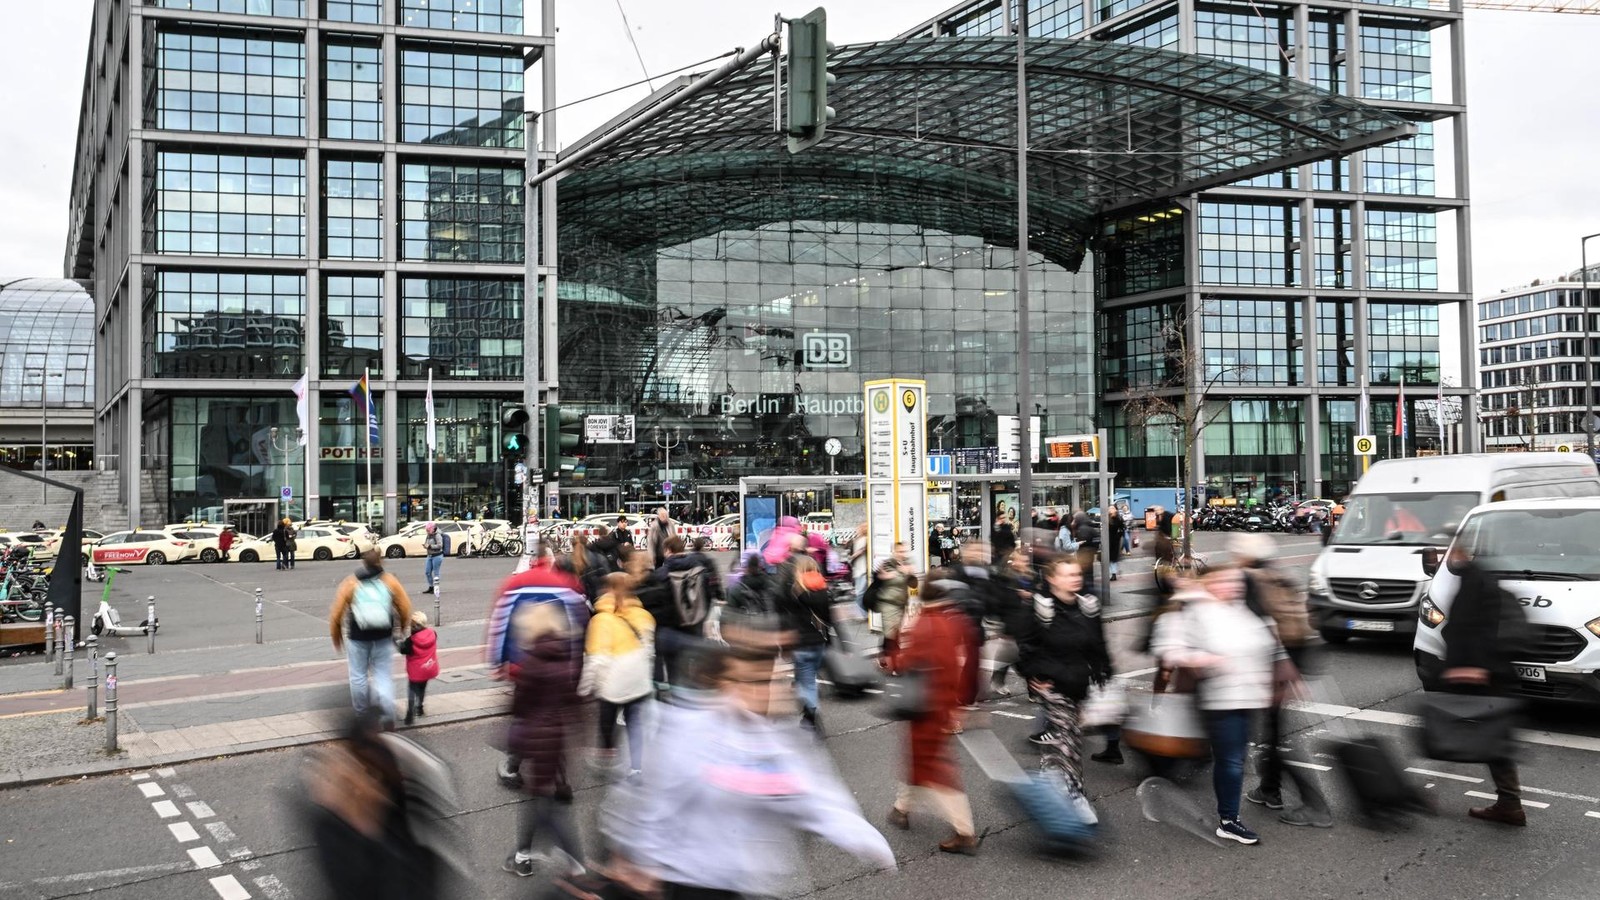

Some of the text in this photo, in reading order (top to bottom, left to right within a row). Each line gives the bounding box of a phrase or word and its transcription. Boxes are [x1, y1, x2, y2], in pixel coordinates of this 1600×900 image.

[808, 337, 846, 364] DB
[720, 394, 932, 417] Berlin Hauptbf
[909, 422, 917, 474] Hauptbahnhof
[926, 457, 940, 475] U
